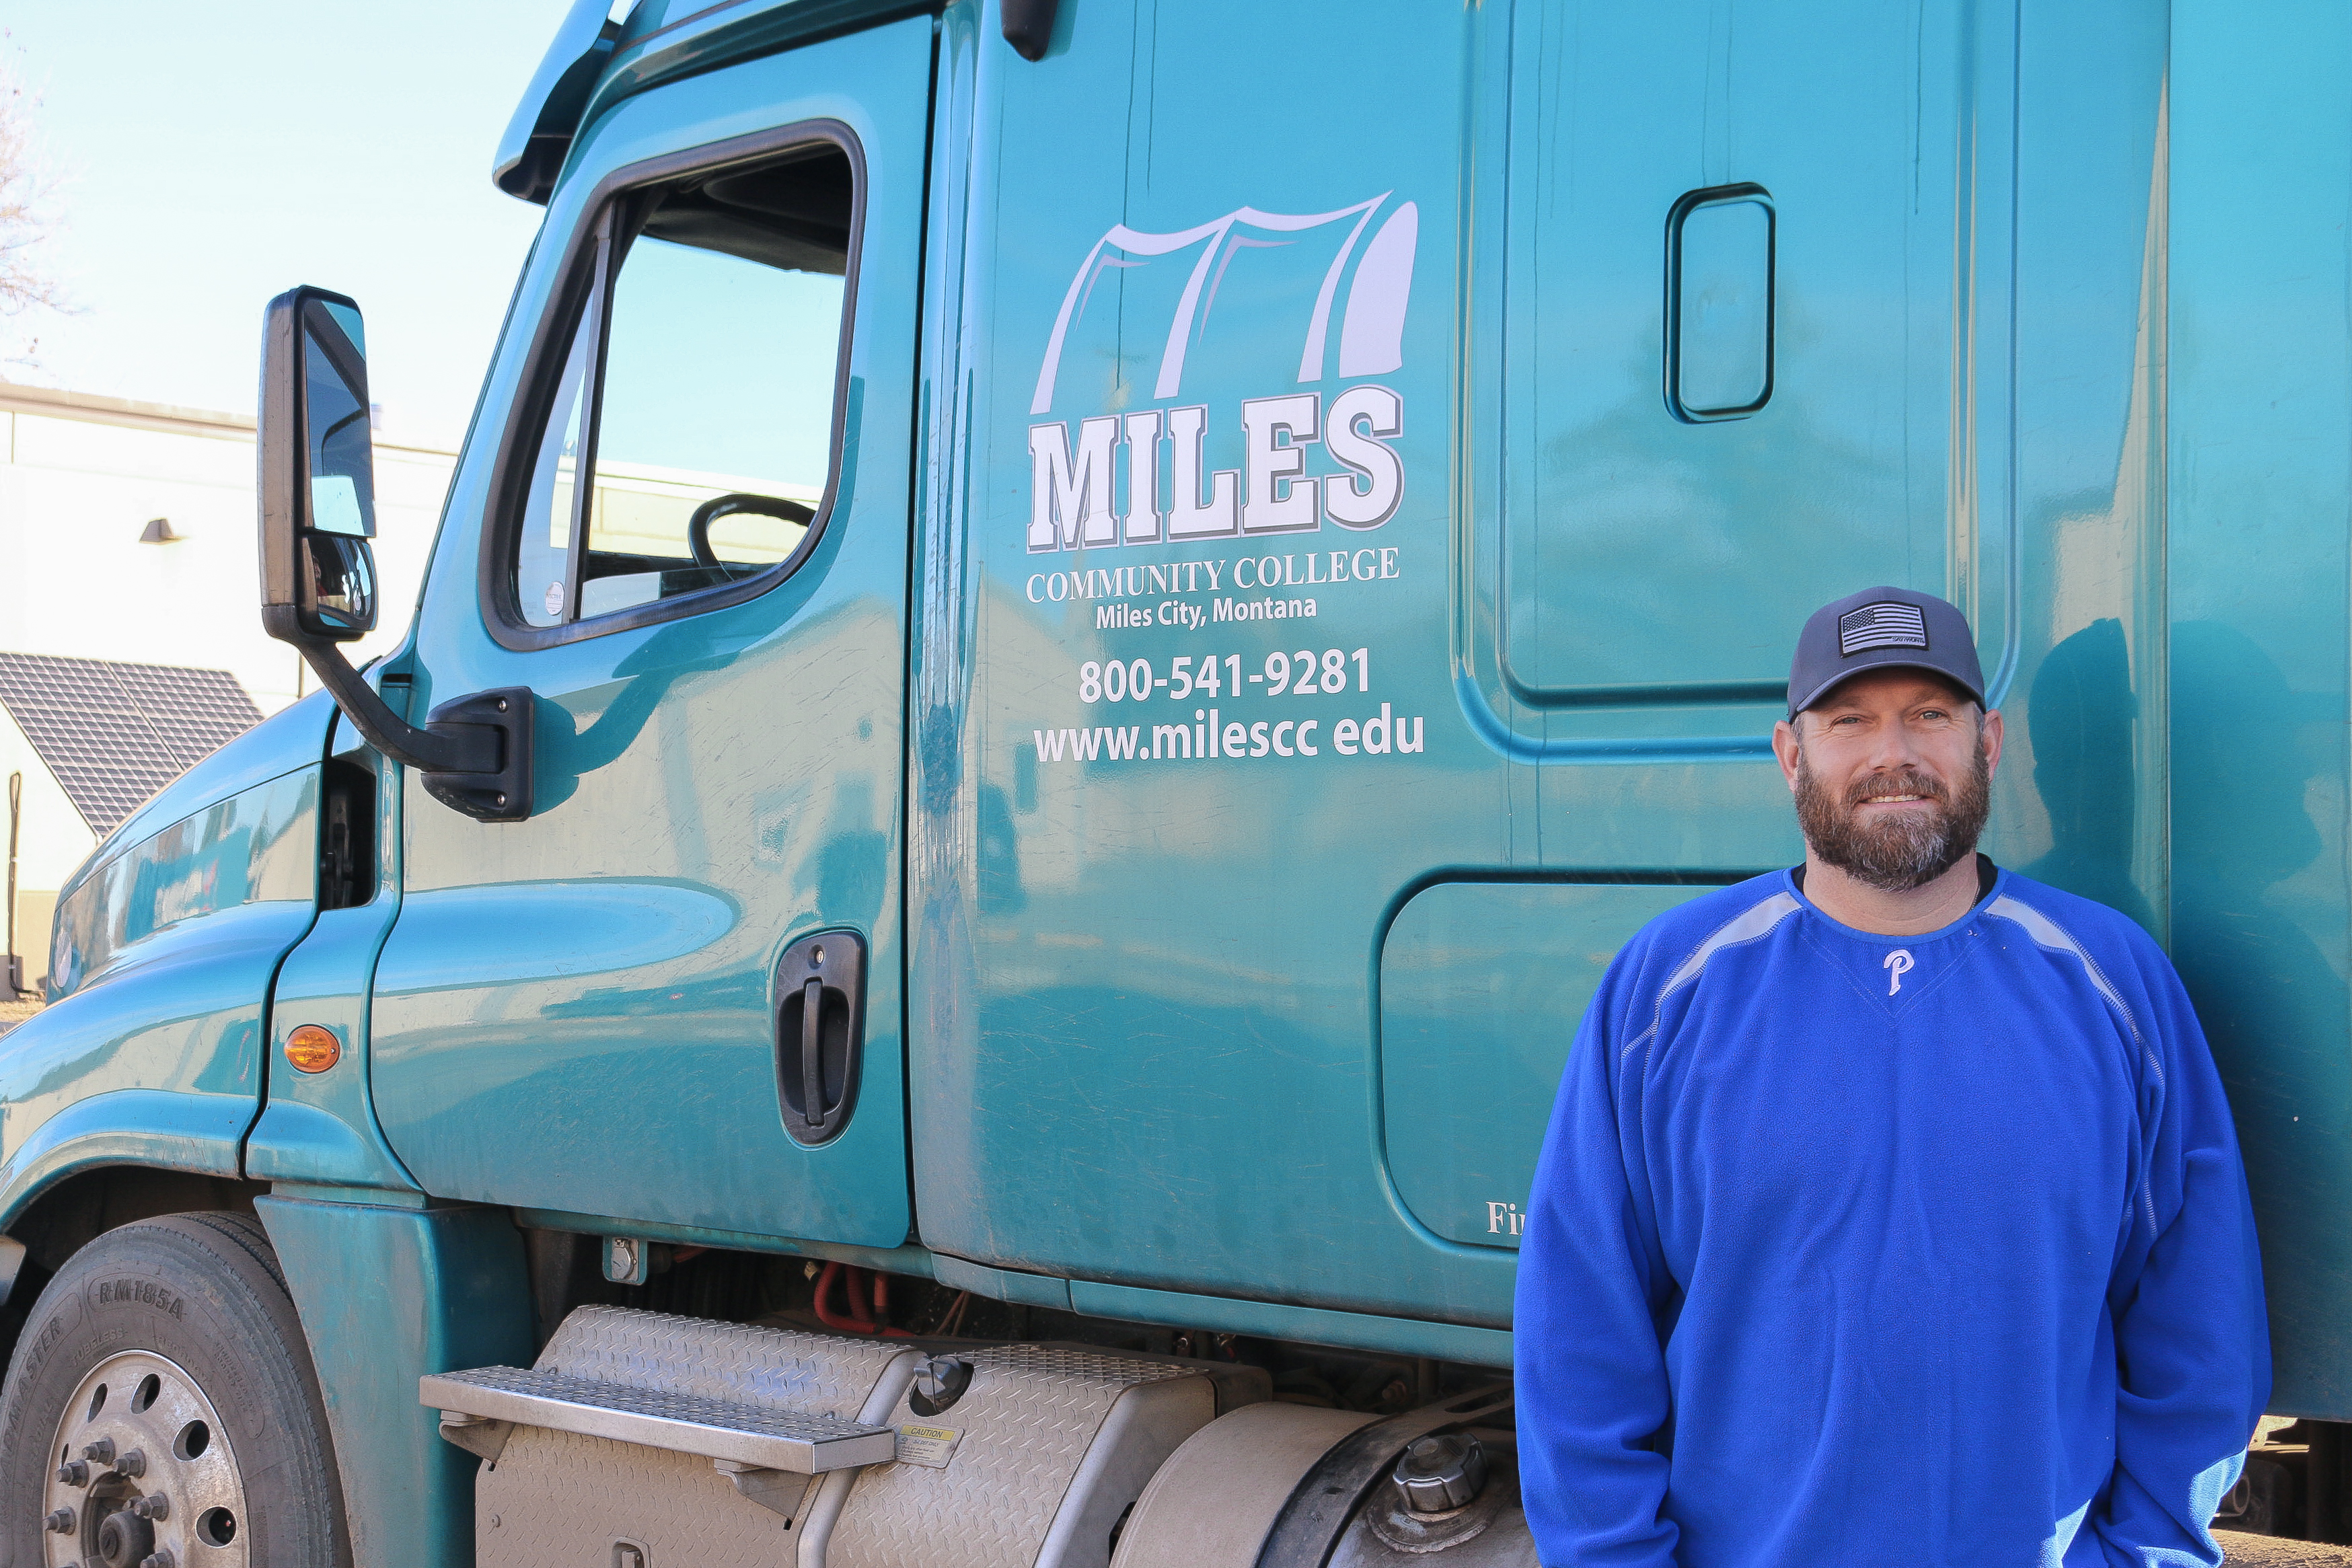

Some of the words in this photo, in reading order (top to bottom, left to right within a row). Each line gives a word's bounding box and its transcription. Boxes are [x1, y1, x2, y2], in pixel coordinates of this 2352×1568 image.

[1027, 383, 1405, 554] MILES
[1026, 559, 1226, 603] COMMUNITY
[1233, 546, 1401, 589] COLLEGE
[1095, 599, 1152, 630] Miles
[1157, 600, 1207, 631] City,
[1212, 594, 1317, 623] Montana
[1078, 647, 1370, 704] 800-541-9281
[1033, 708, 1319, 762] www.milescc
[1333, 702, 1424, 755] edu
[100, 1277, 185, 1322] RM185A
[910, 1427, 943, 1438] CAUTION
